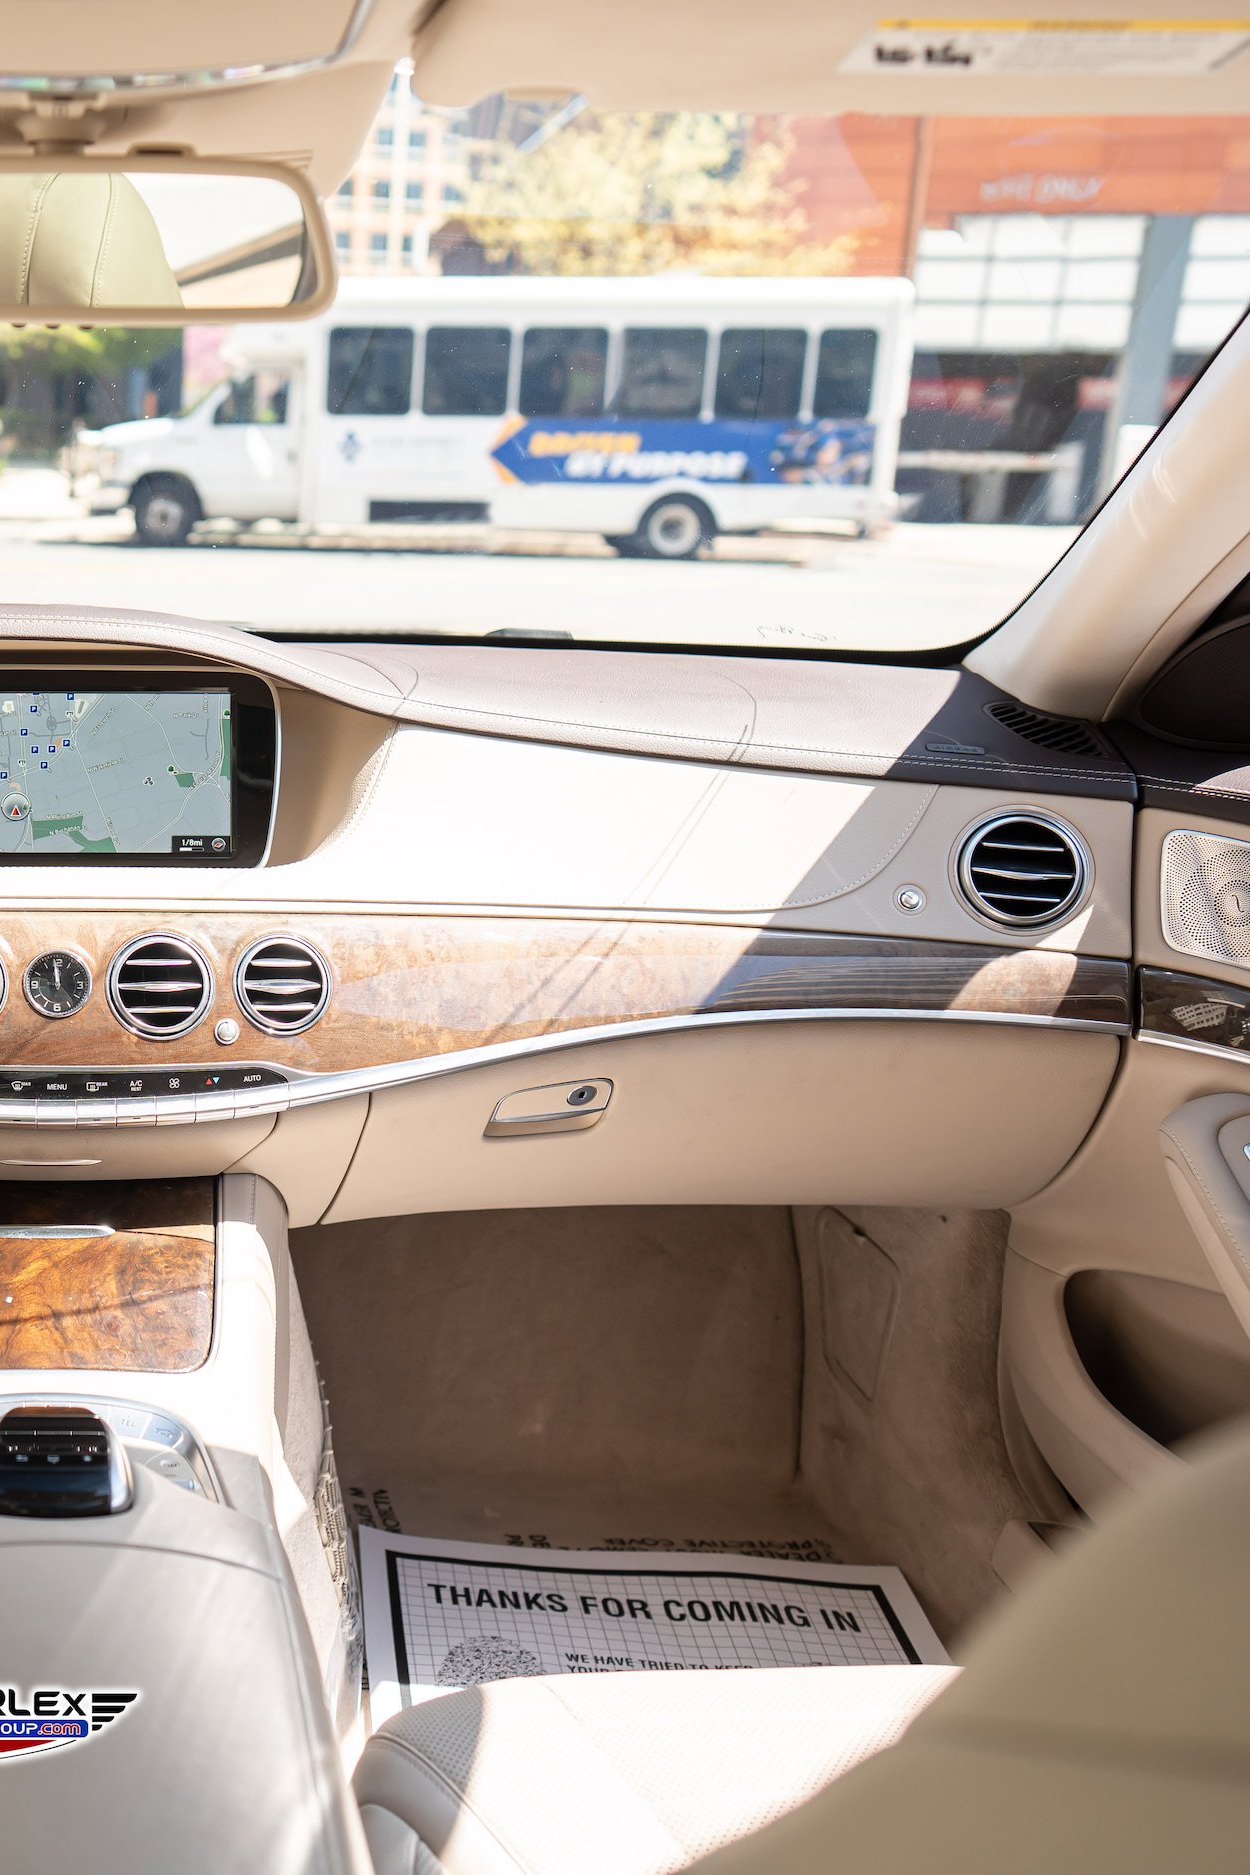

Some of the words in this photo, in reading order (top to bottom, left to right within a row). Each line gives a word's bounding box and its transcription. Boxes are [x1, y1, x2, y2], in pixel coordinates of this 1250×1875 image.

[181, 839, 204, 848] 1/8mi
[30, 980, 39, 990] 9
[76, 981, 84, 990] 3
[53, 1003, 62, 1012] 6
[243, 1074, 262, 1083] AUTO
[120, 1418, 136, 1428] TEL
[427, 1583, 569, 1614] THANKS
[579, 1596, 654, 1620] FOR
[662, 1600, 811, 1628] COMING
[820, 1608, 862, 1634] IN
[564, 1652, 590, 1664] WE
[594, 1656, 634, 1668] HAVE
[638, 1659, 685, 1670] TRIED
